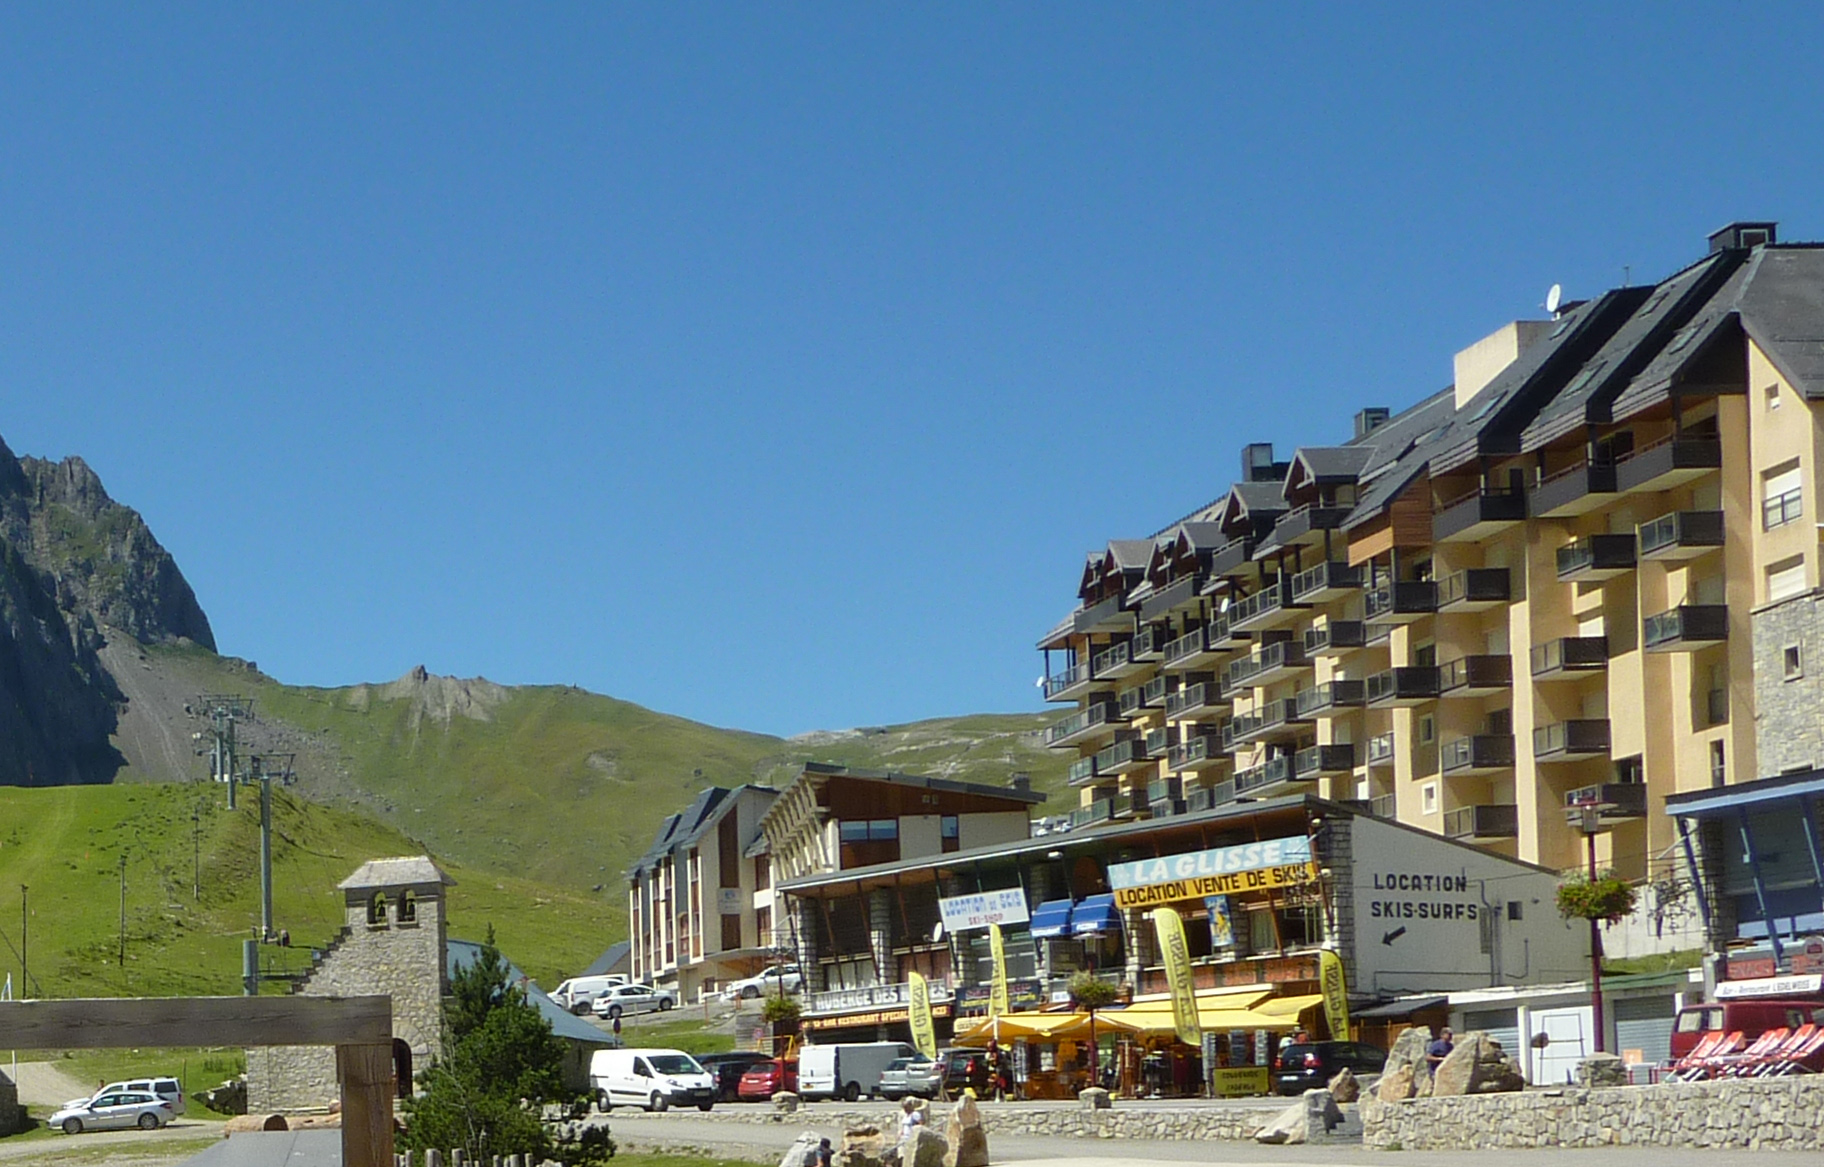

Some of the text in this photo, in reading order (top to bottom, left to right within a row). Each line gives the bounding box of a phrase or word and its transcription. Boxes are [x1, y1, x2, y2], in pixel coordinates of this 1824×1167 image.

[1133, 842, 1282, 883] LA GLISSE
[1119, 881, 1188, 905] LOCATION
[1193, 873, 1241, 895] VENTE
[1247, 869, 1267, 888] DE
[1373, 873, 1467, 893] LOCATION
[873, 985, 899, 1005] DES
